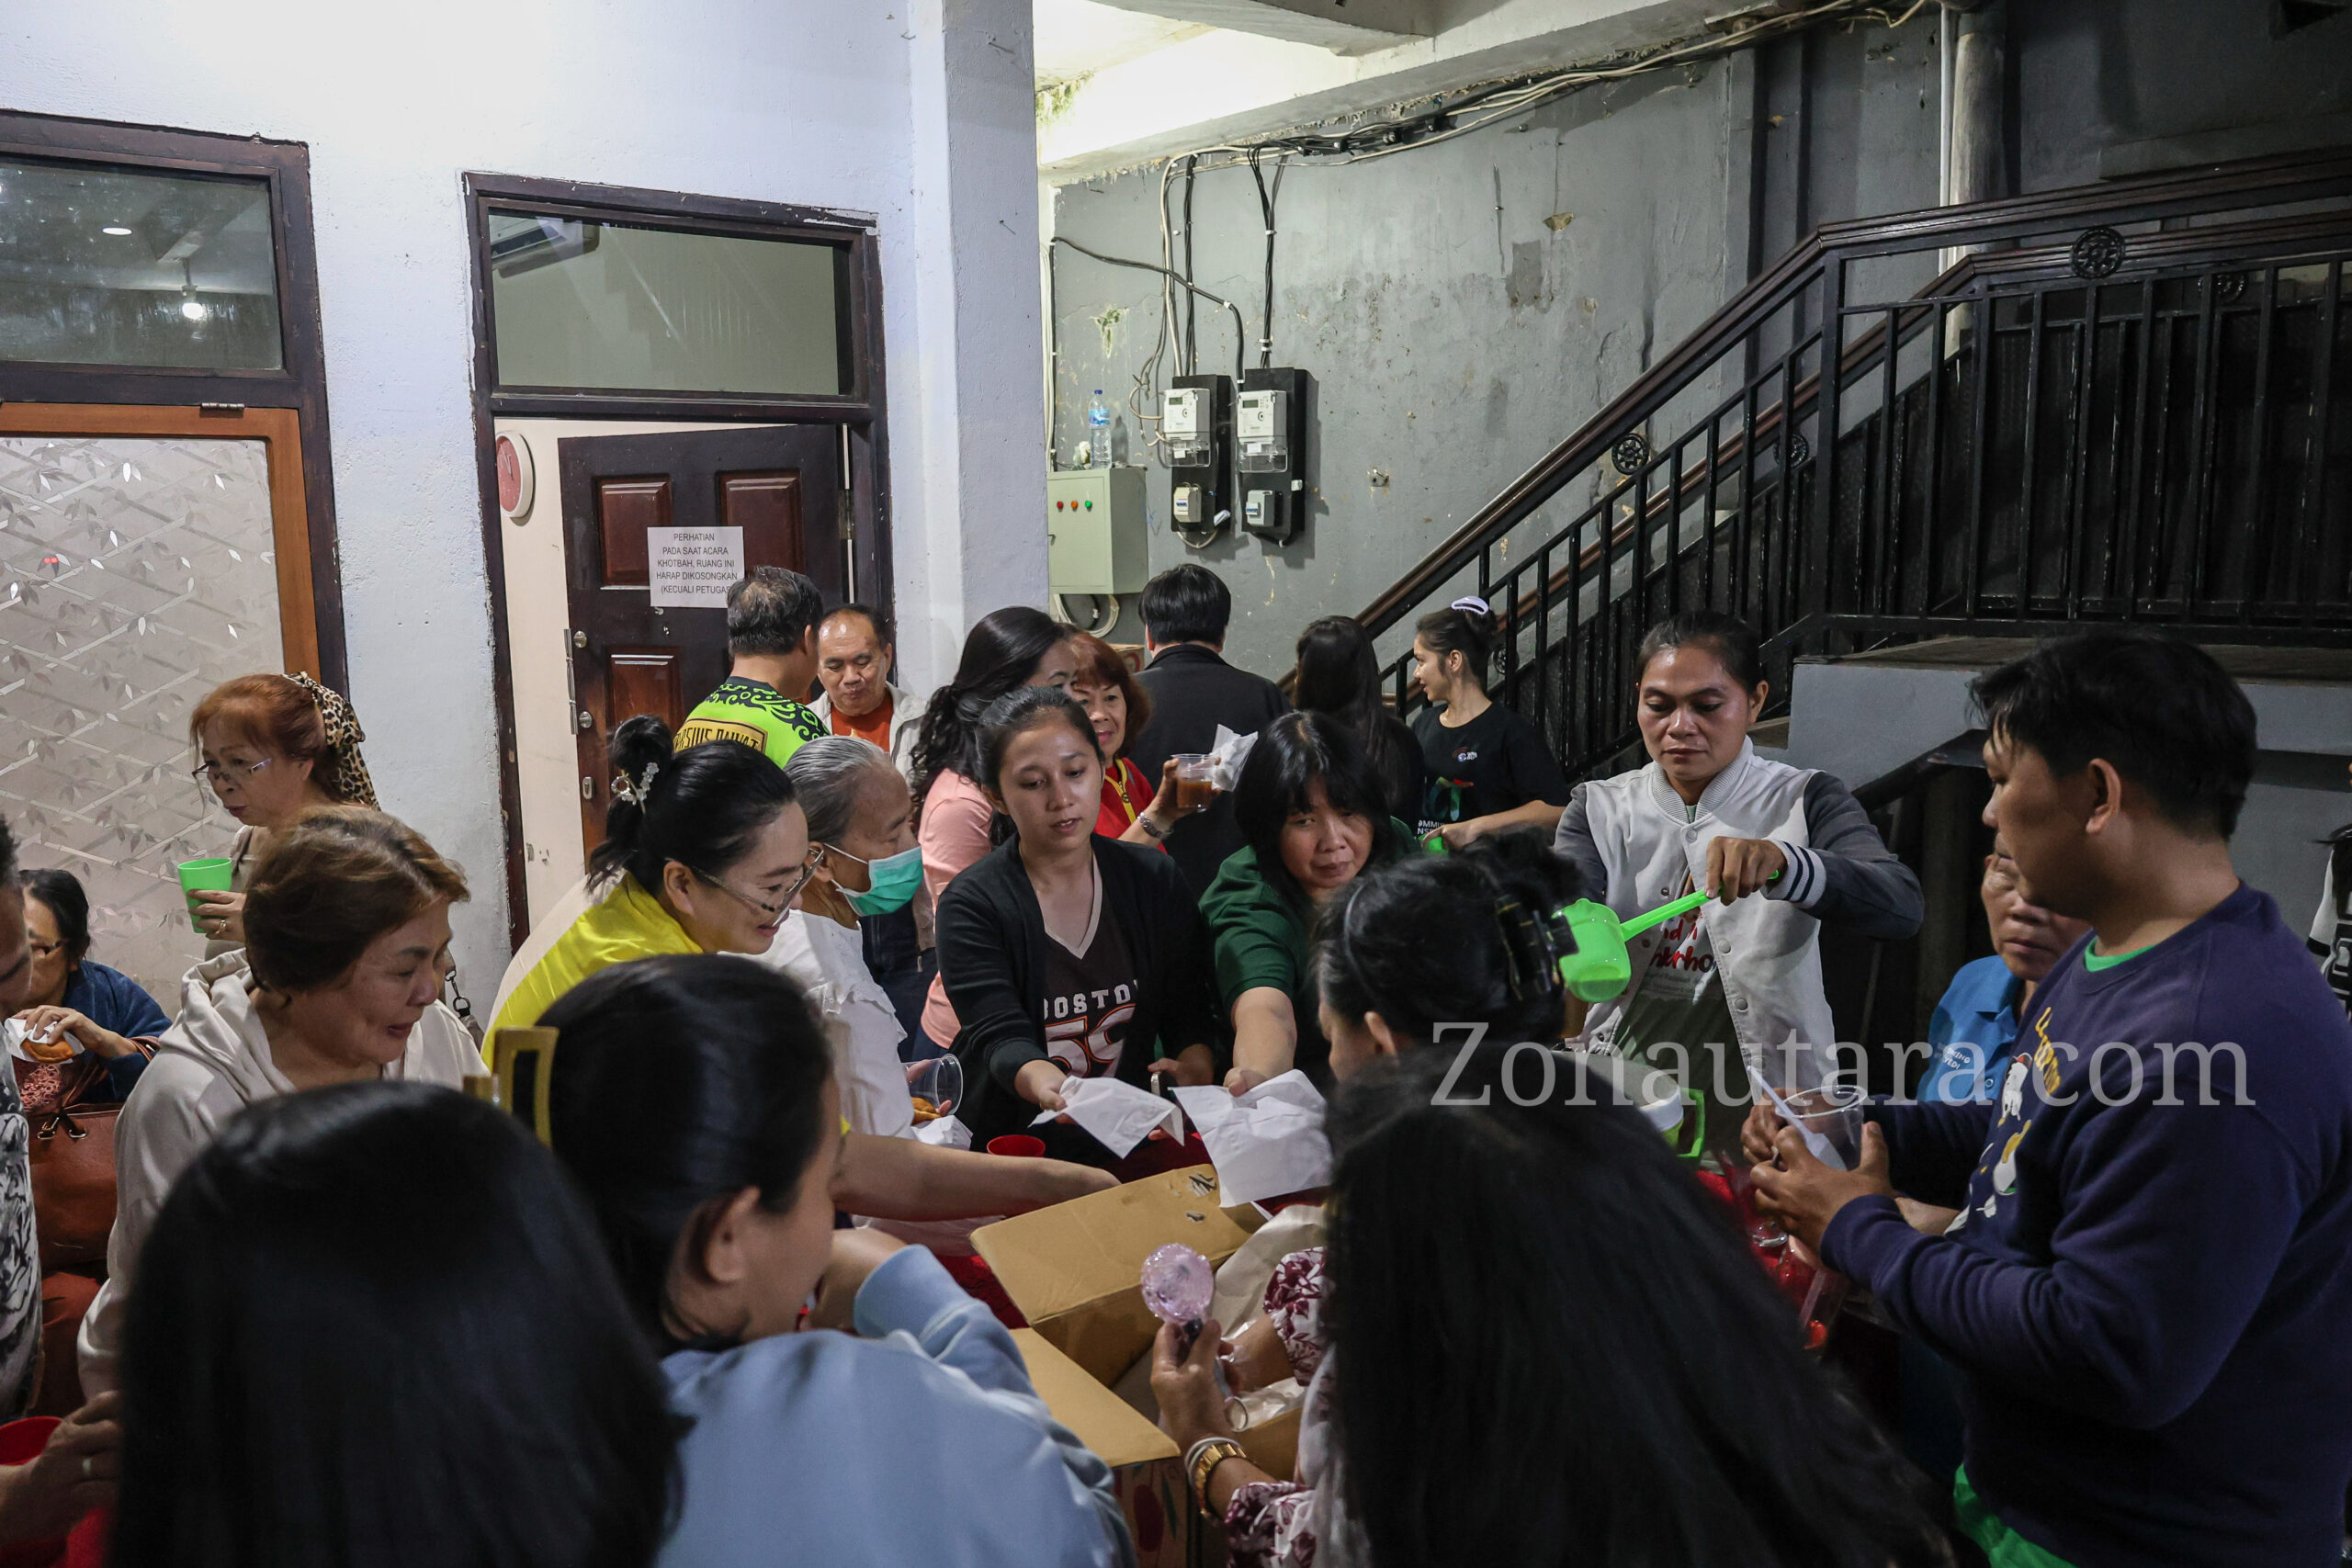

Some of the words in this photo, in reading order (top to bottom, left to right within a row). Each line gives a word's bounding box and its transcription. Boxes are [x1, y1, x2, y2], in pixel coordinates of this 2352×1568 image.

[673, 533, 715, 541] PERHATIAN
[662, 547, 682, 555] PADA
[683, 547, 702, 555] SAAT
[703, 547, 729, 555] ACARA
[657, 559, 695, 568] KHOTBAH,
[696, 559, 723, 568] RUANG
[724, 559, 735, 568] INI
[656, 571, 681, 580] HARAP
[682, 571, 738, 580] DIKOSONGKAN
[662, 585, 695, 594] (KECUALI
[1044, 979, 1138, 1020] OSTO
